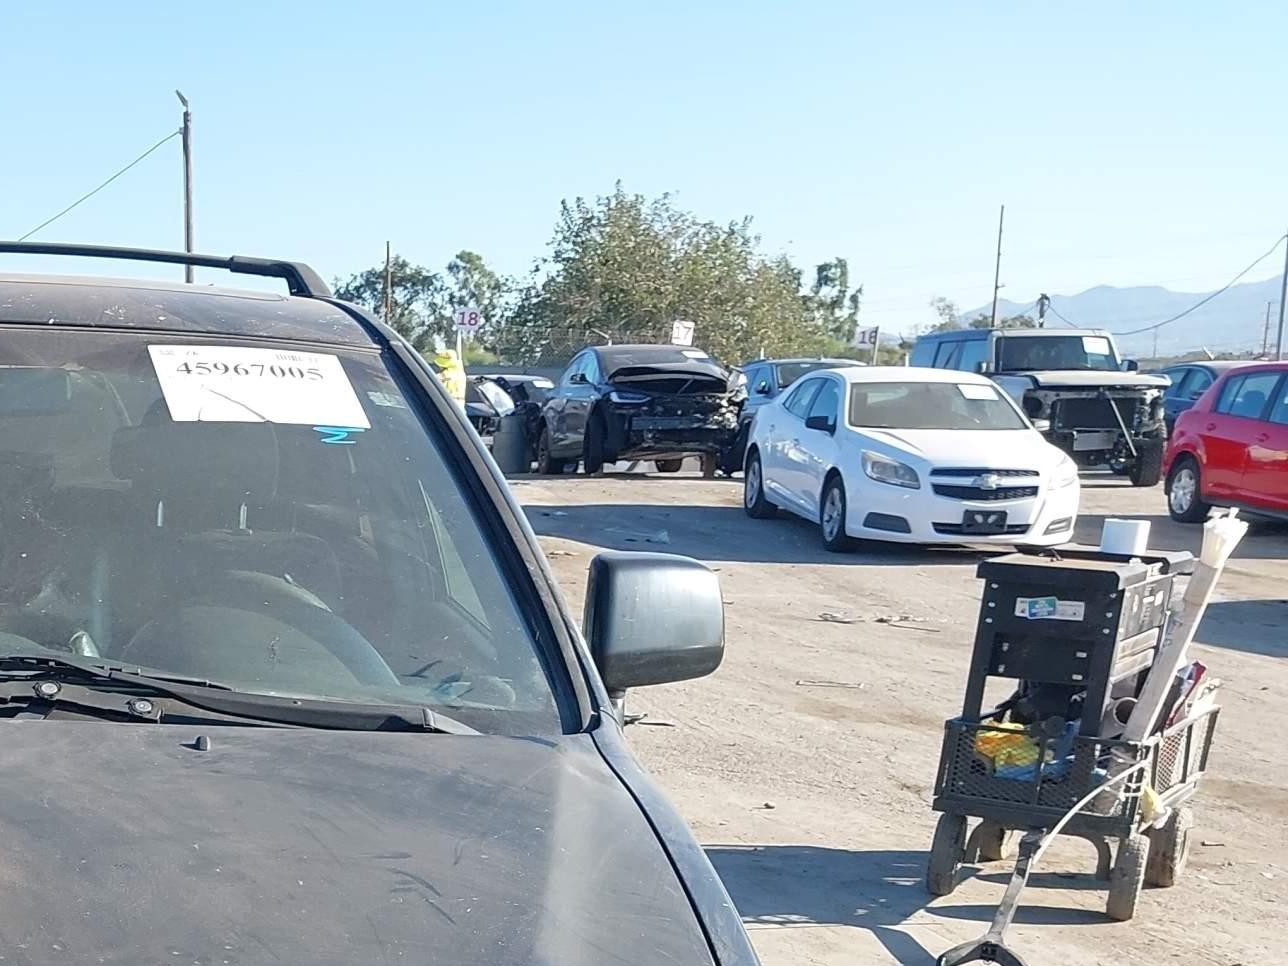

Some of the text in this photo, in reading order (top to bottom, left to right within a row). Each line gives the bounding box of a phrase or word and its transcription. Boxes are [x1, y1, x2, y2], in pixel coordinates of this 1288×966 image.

[458, 311, 478, 326] 18
[672, 326, 692, 340] 17
[176, 361, 324, 381] 45967005
